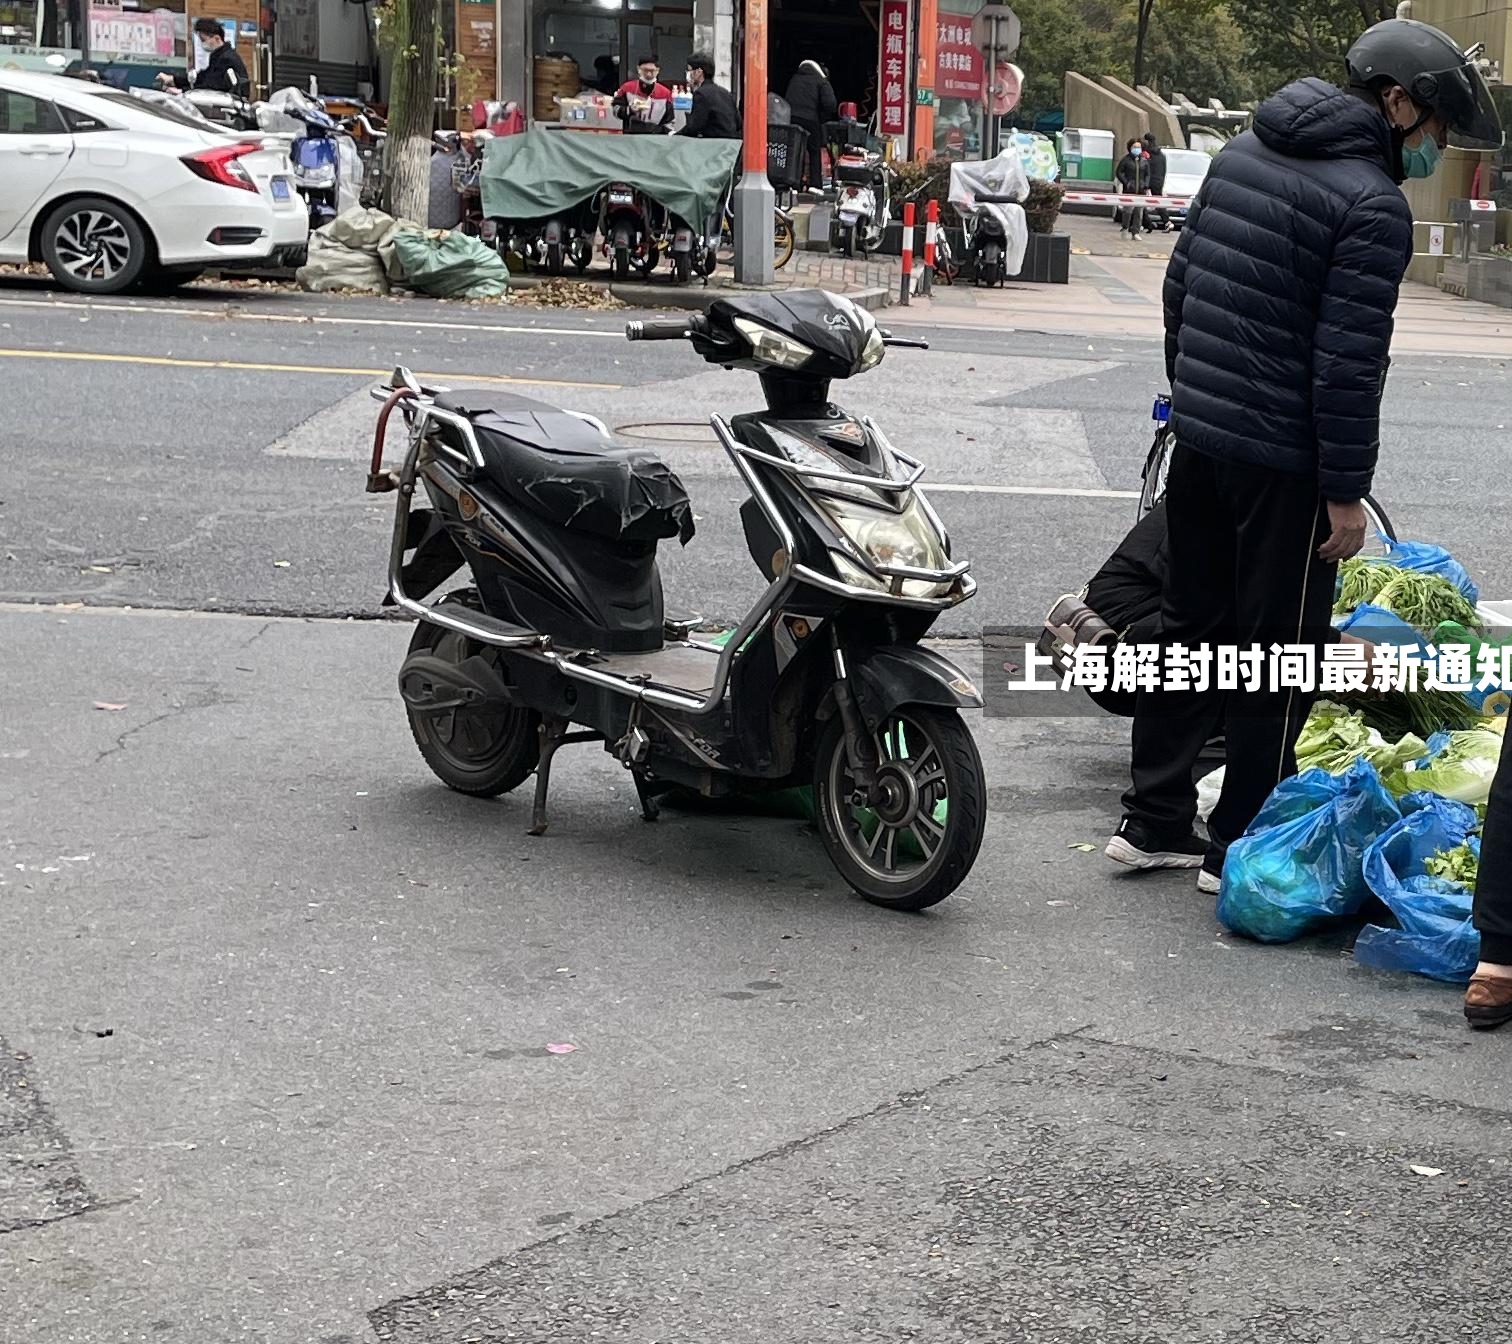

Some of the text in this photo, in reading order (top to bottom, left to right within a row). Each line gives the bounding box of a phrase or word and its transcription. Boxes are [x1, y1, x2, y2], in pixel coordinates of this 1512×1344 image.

[885, 9, 904, 126] 电瓶车修理
